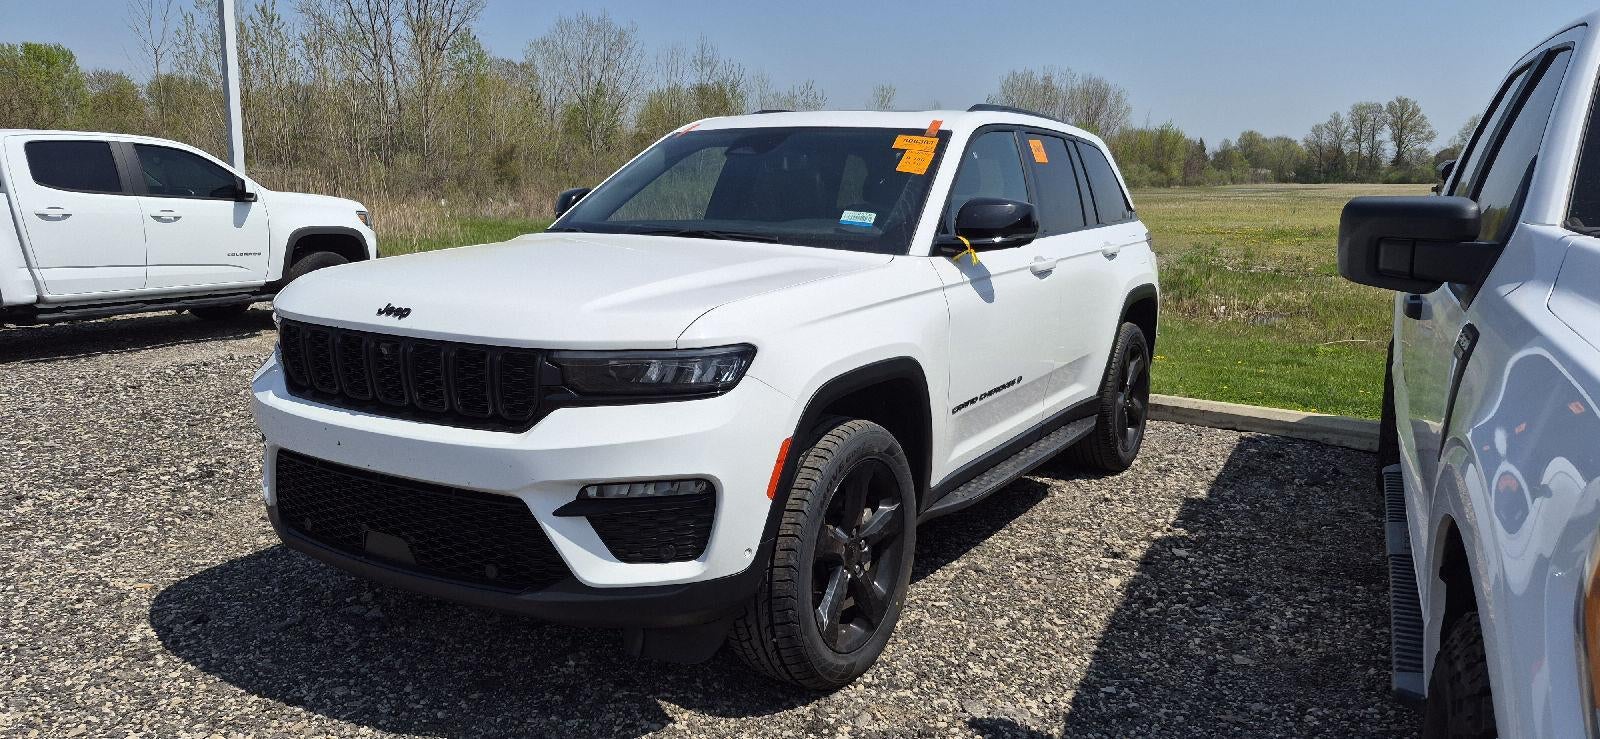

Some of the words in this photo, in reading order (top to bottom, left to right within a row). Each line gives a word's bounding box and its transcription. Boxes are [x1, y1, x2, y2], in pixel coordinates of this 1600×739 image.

[376, 303, 412, 321] Jeep
[951, 396, 978, 415] GRAND
[979, 378, 1017, 401] CHEROKEE
